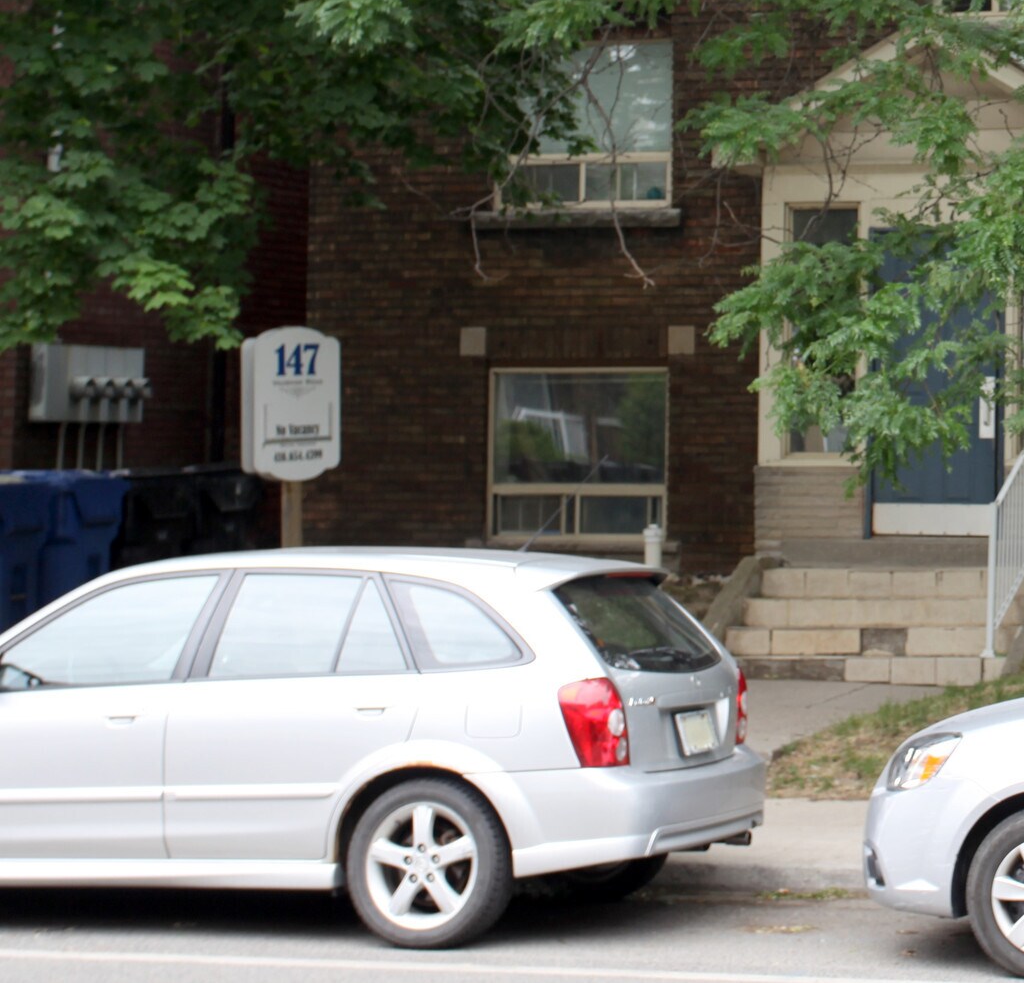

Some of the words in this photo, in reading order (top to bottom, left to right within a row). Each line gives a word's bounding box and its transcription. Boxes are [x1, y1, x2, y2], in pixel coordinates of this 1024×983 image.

[275, 343, 320, 376] 147
[276, 424, 286, 436] No
[288, 423, 320, 437] Vacancy
